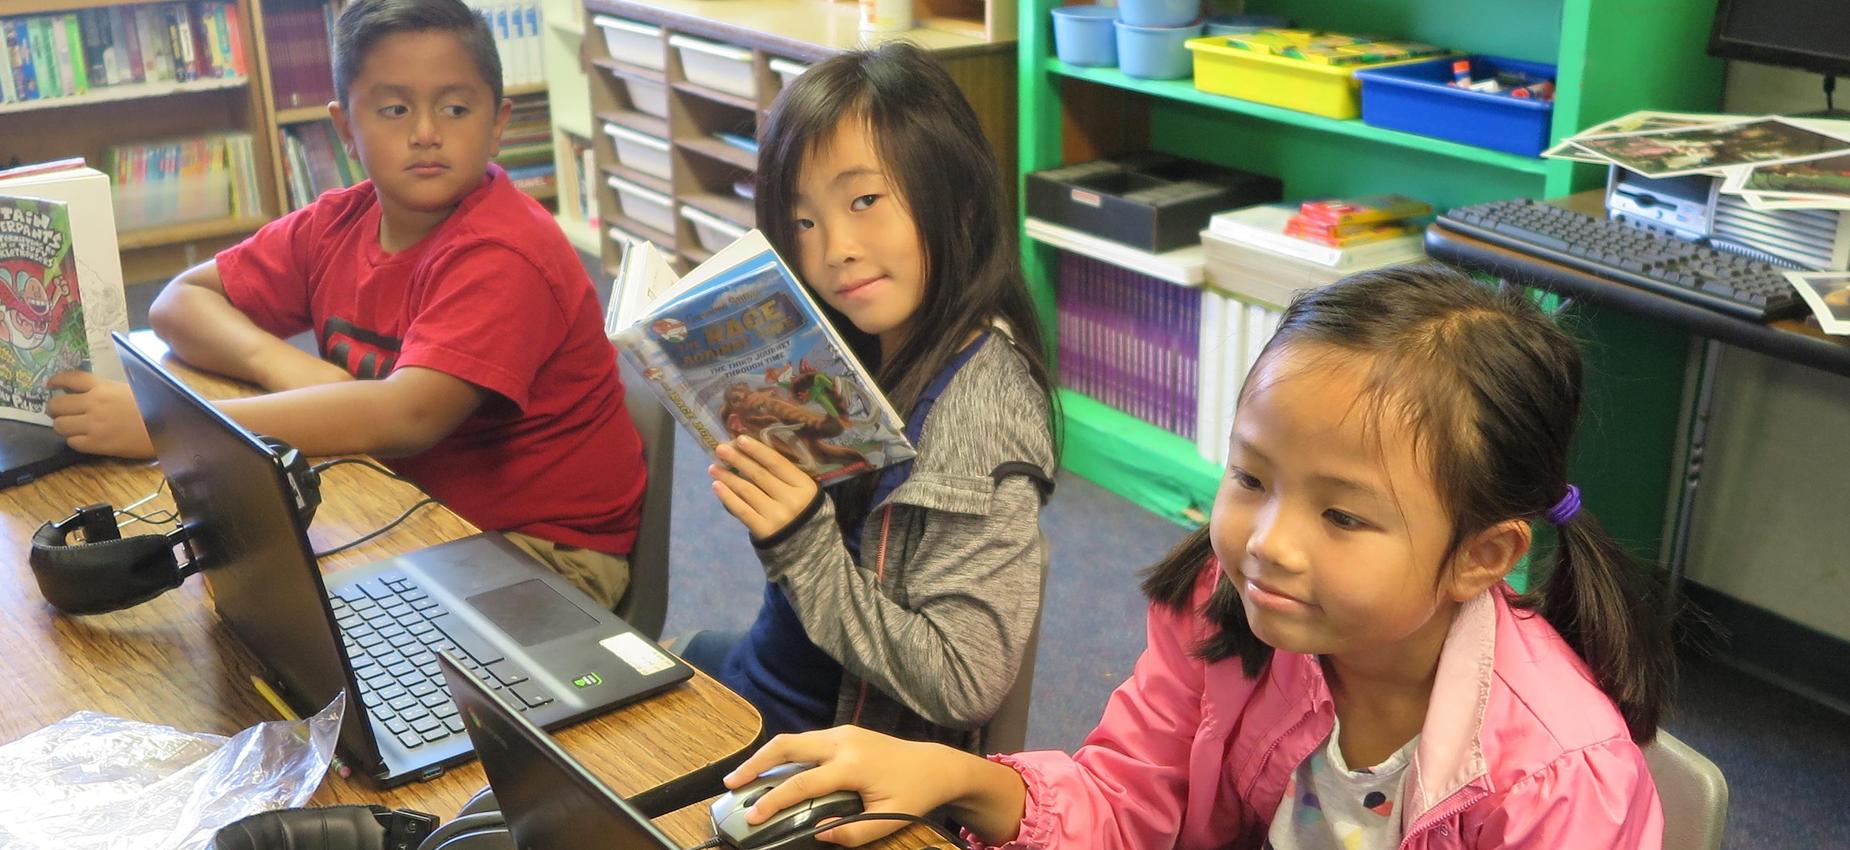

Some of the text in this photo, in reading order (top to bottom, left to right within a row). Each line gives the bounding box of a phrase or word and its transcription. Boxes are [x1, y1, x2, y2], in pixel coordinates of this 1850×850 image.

[703, 299, 777, 345] RACE
[710, 340, 791, 375] THE THIRD JOURNEY
[765, 352, 786, 364] TIME
